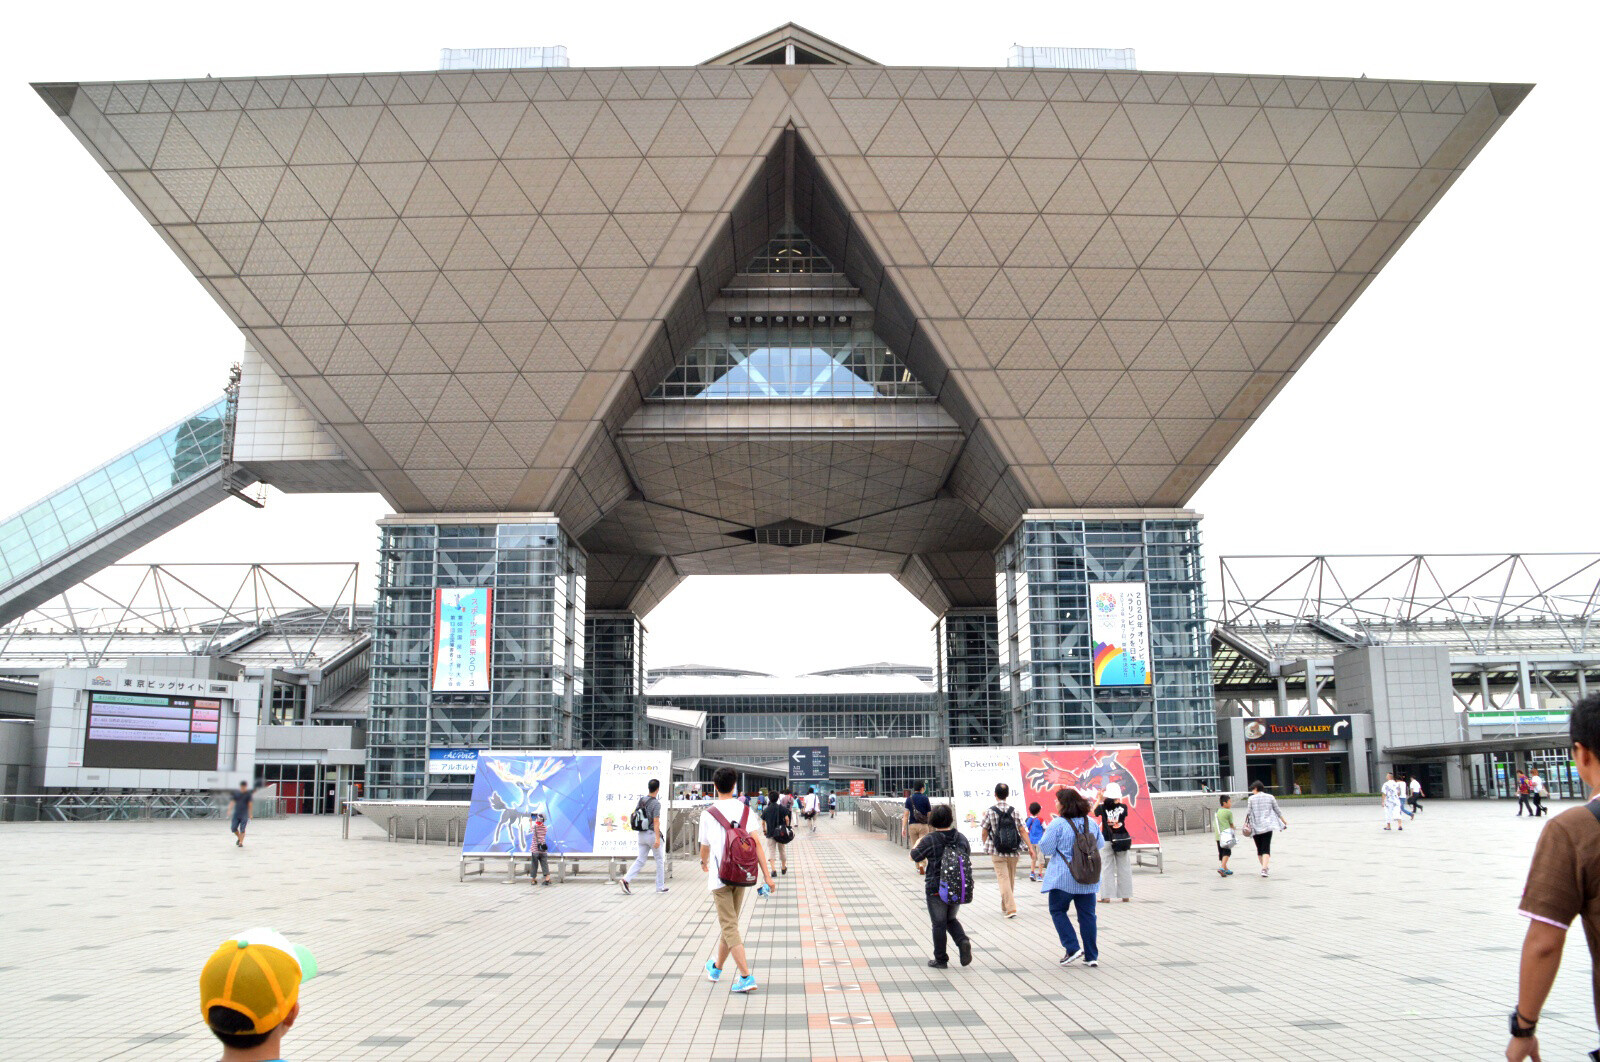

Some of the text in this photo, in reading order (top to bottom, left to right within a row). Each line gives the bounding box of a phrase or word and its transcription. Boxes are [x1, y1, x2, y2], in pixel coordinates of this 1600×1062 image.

[123, 678, 205, 692] 東京ビッグサイト
